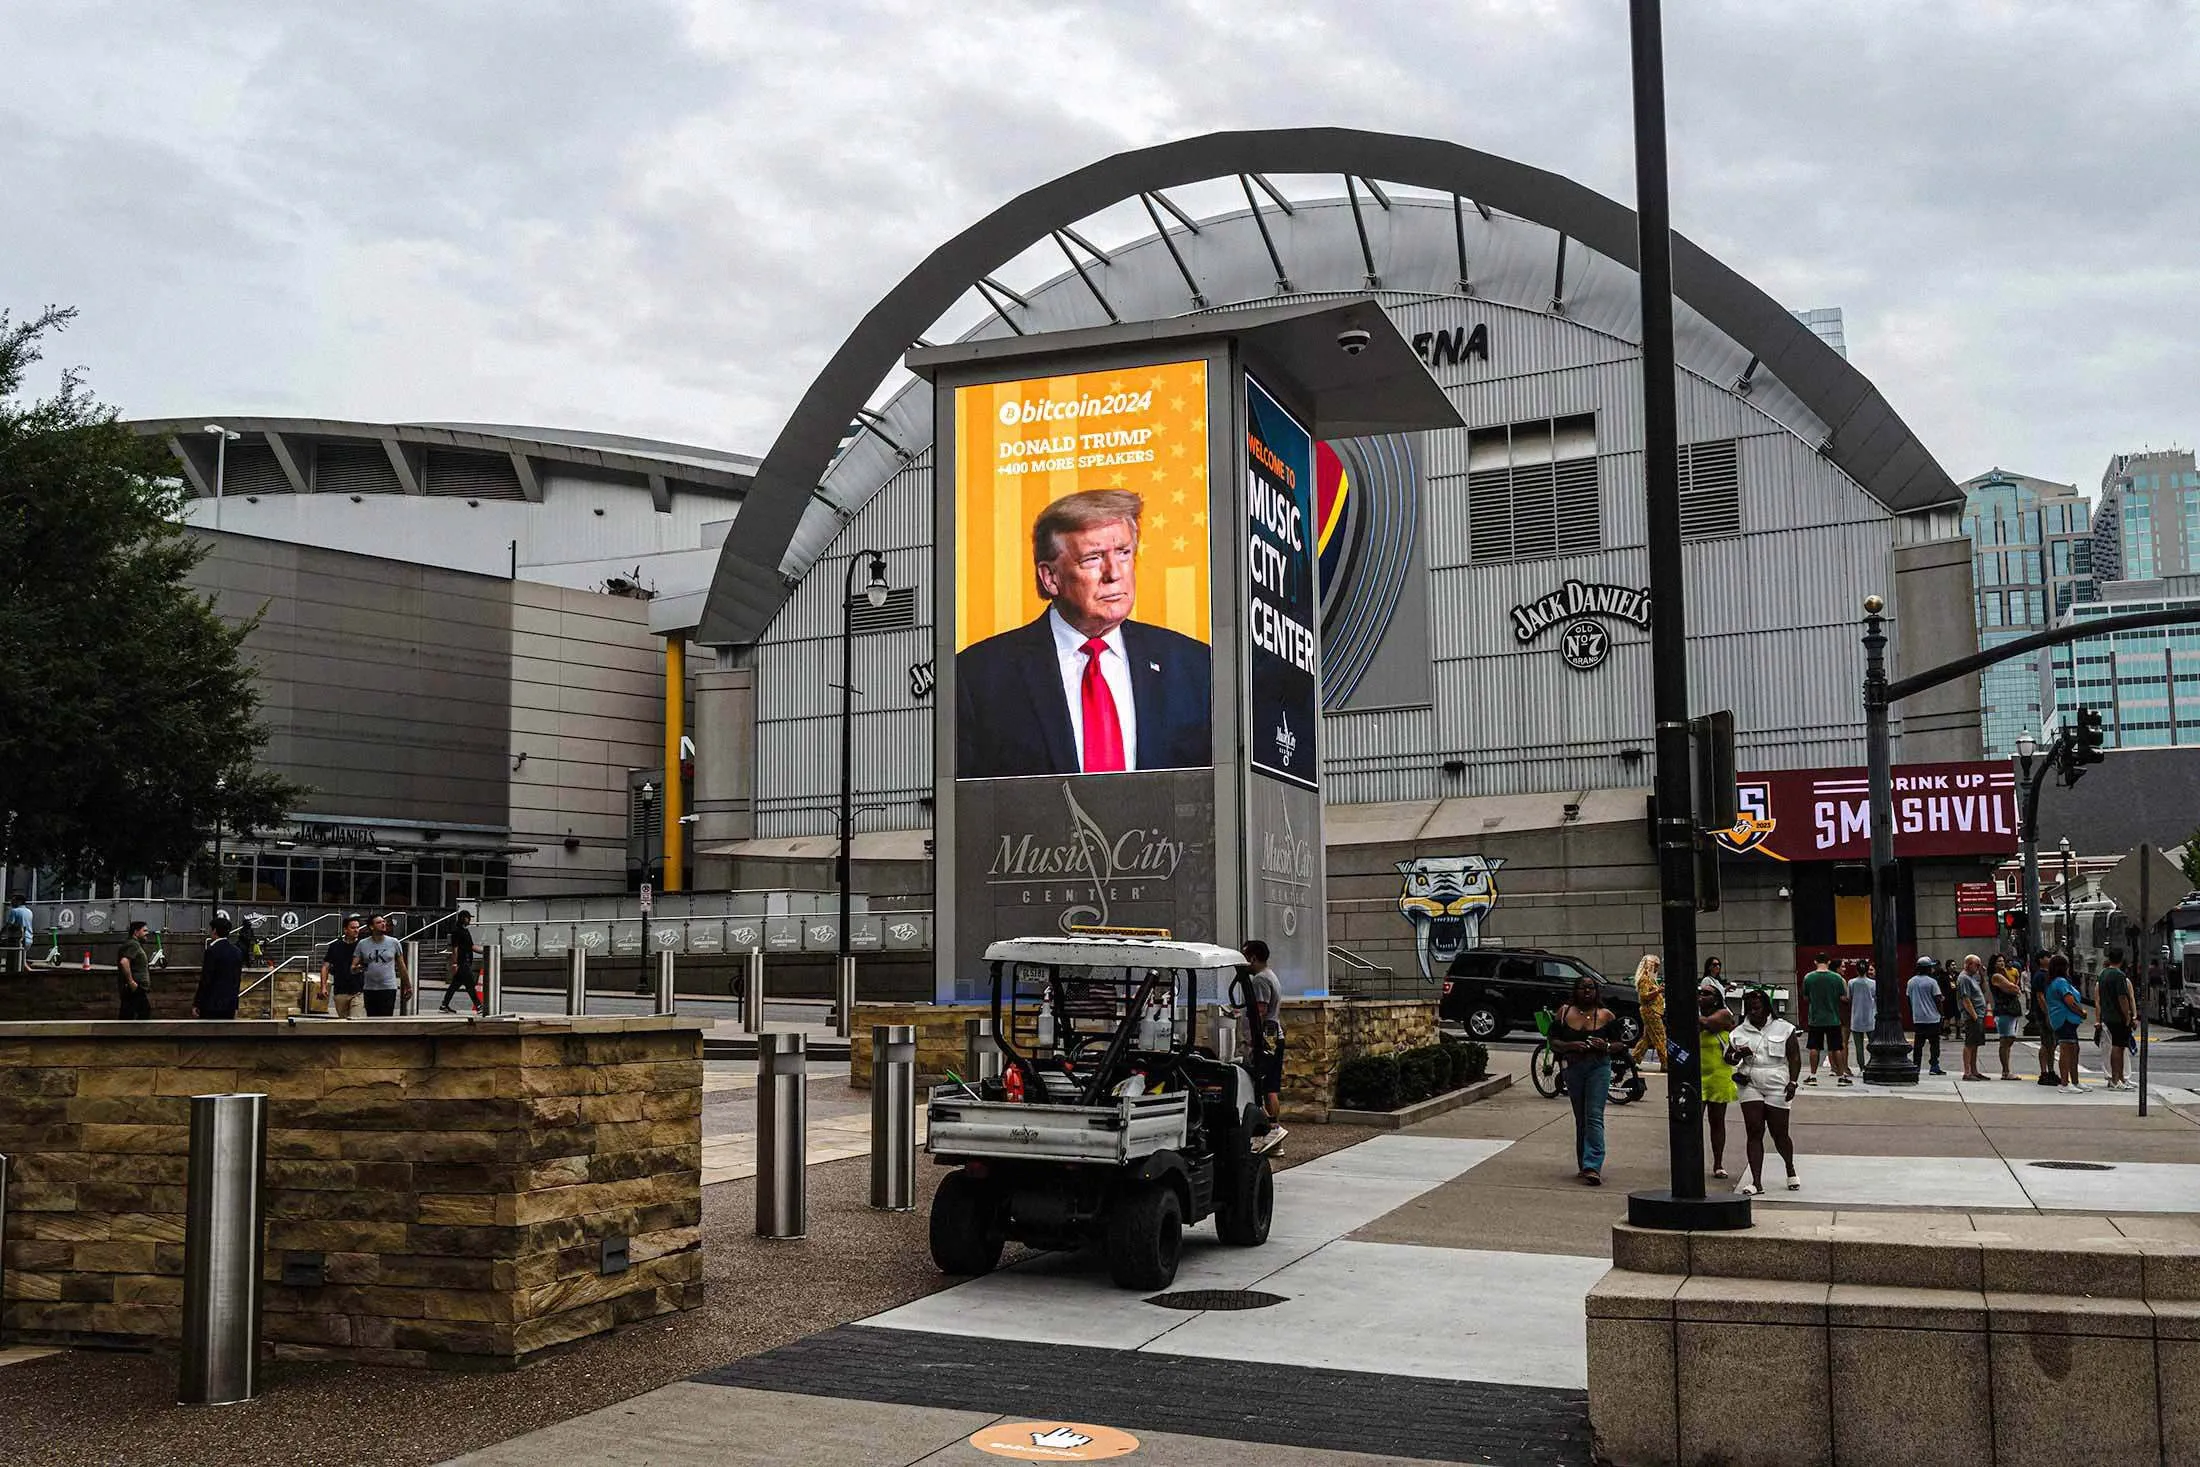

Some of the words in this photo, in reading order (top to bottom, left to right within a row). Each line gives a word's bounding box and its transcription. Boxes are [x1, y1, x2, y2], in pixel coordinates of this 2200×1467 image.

[1000, 436, 1075, 458] DONALD
[1080, 429, 1152, 450] TRUMP
[1032, 457, 1074, 472] MORE
[1078, 450, 1154, 468] SPEAKERS
[1248, 432, 1285, 480] WELCOME
[1286, 466, 1296, 489] TO
[1249, 469, 1302, 552] MUSIC
[1250, 534, 1287, 598] CITY
[1251, 597, 1315, 675] CENTER
[1573, 656, 1598, 665] BRAND
[1891, 776, 1949, 791] RINK
[1956, 774, 1985, 788] UP
[987, 830, 1094, 875] Music
[1112, 828, 1184, 881] City
[1261, 831, 1292, 875] Music
[1295, 839, 1315, 886] City
[1023, 887, 1140, 903] CENTER
